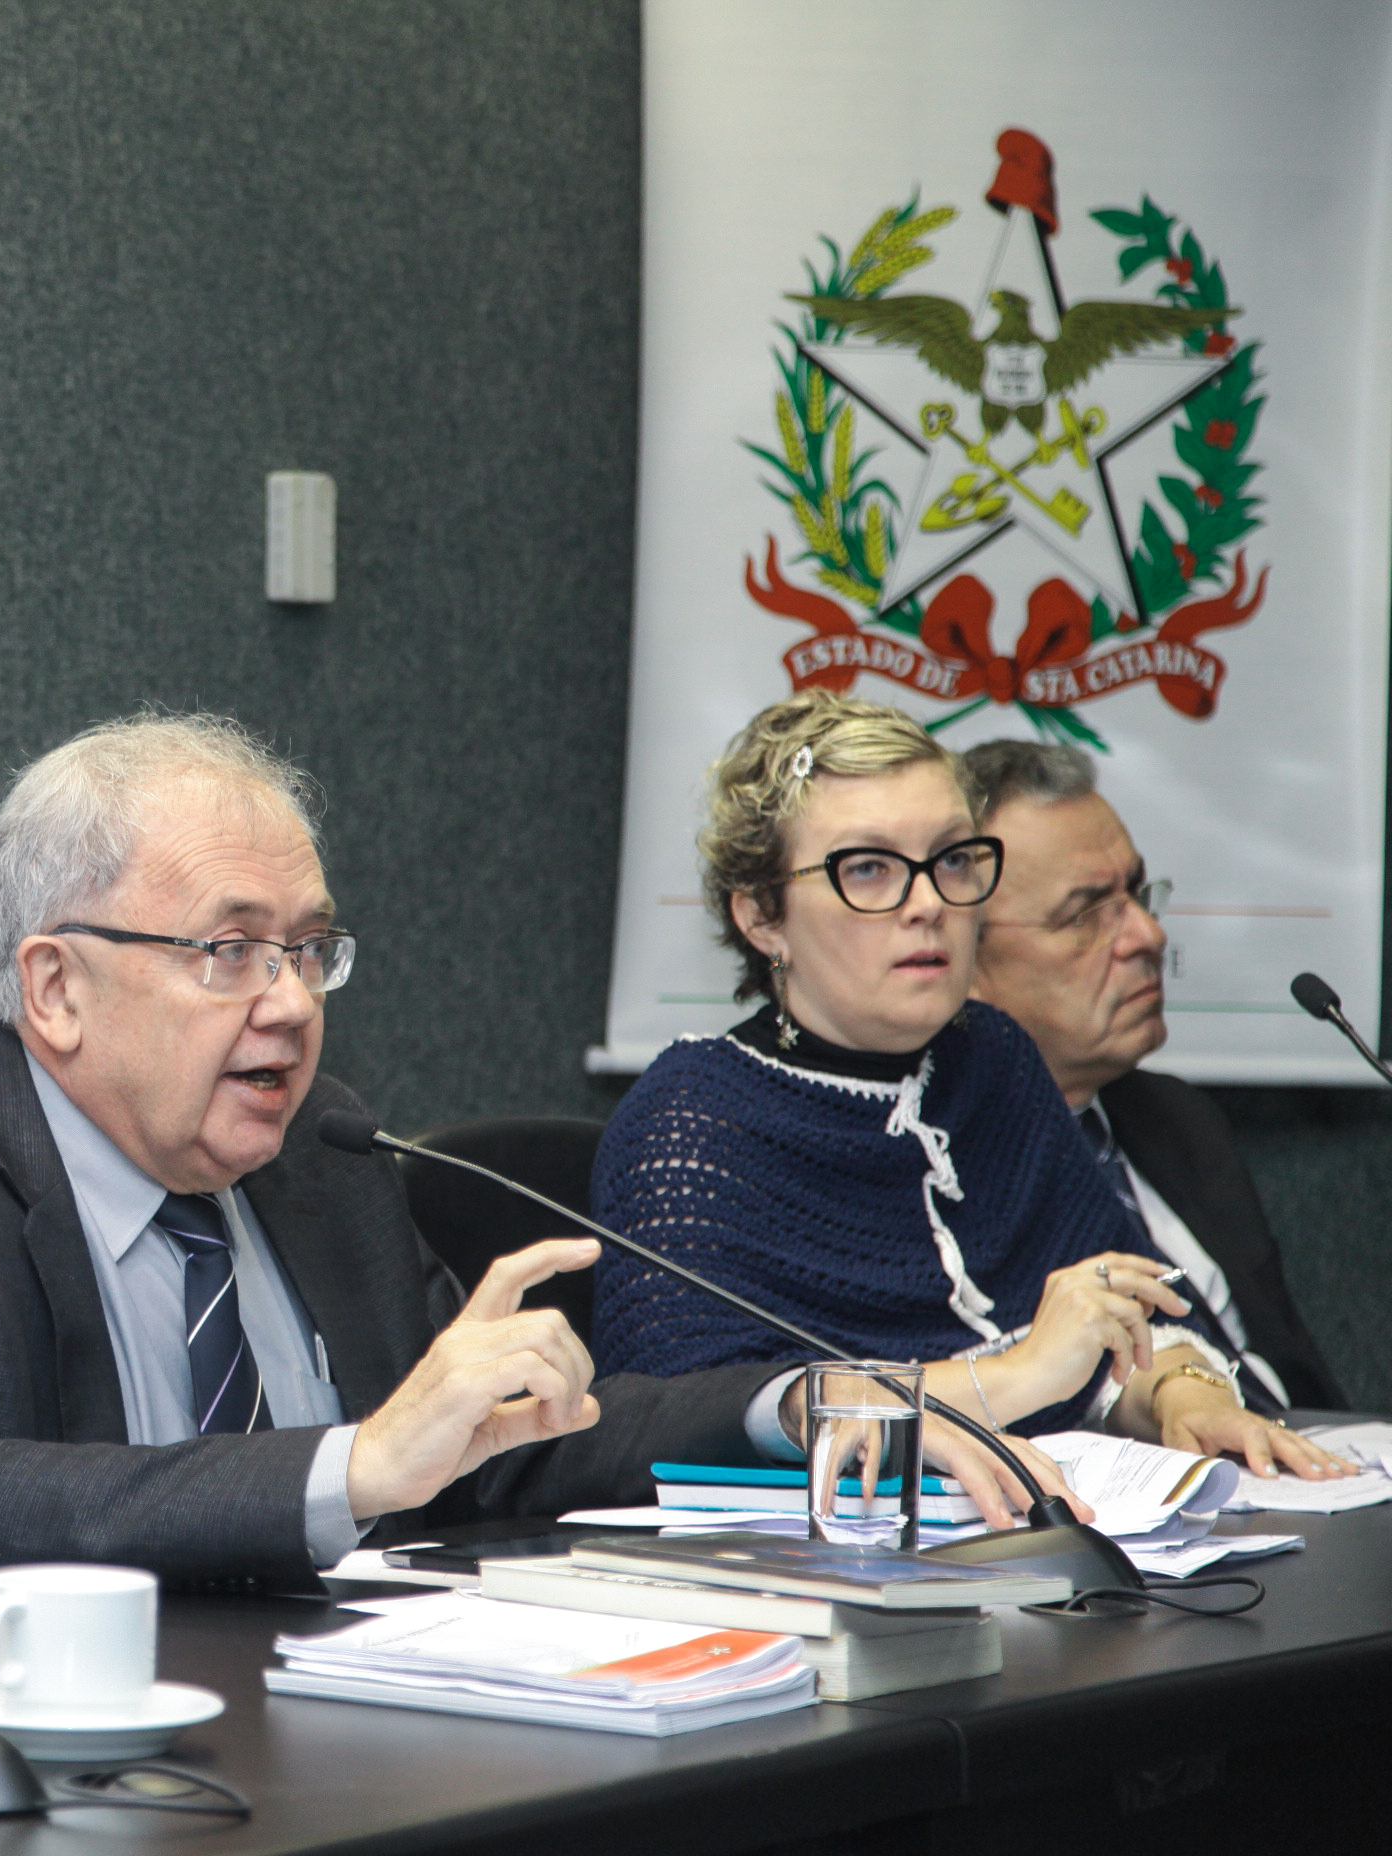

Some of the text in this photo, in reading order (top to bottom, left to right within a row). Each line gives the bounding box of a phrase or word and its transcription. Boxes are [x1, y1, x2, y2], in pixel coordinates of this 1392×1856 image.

[792, 634, 915, 679] ESTADO
[915, 661, 961, 697] DE
[1084, 641, 1216, 691] CATARINA
